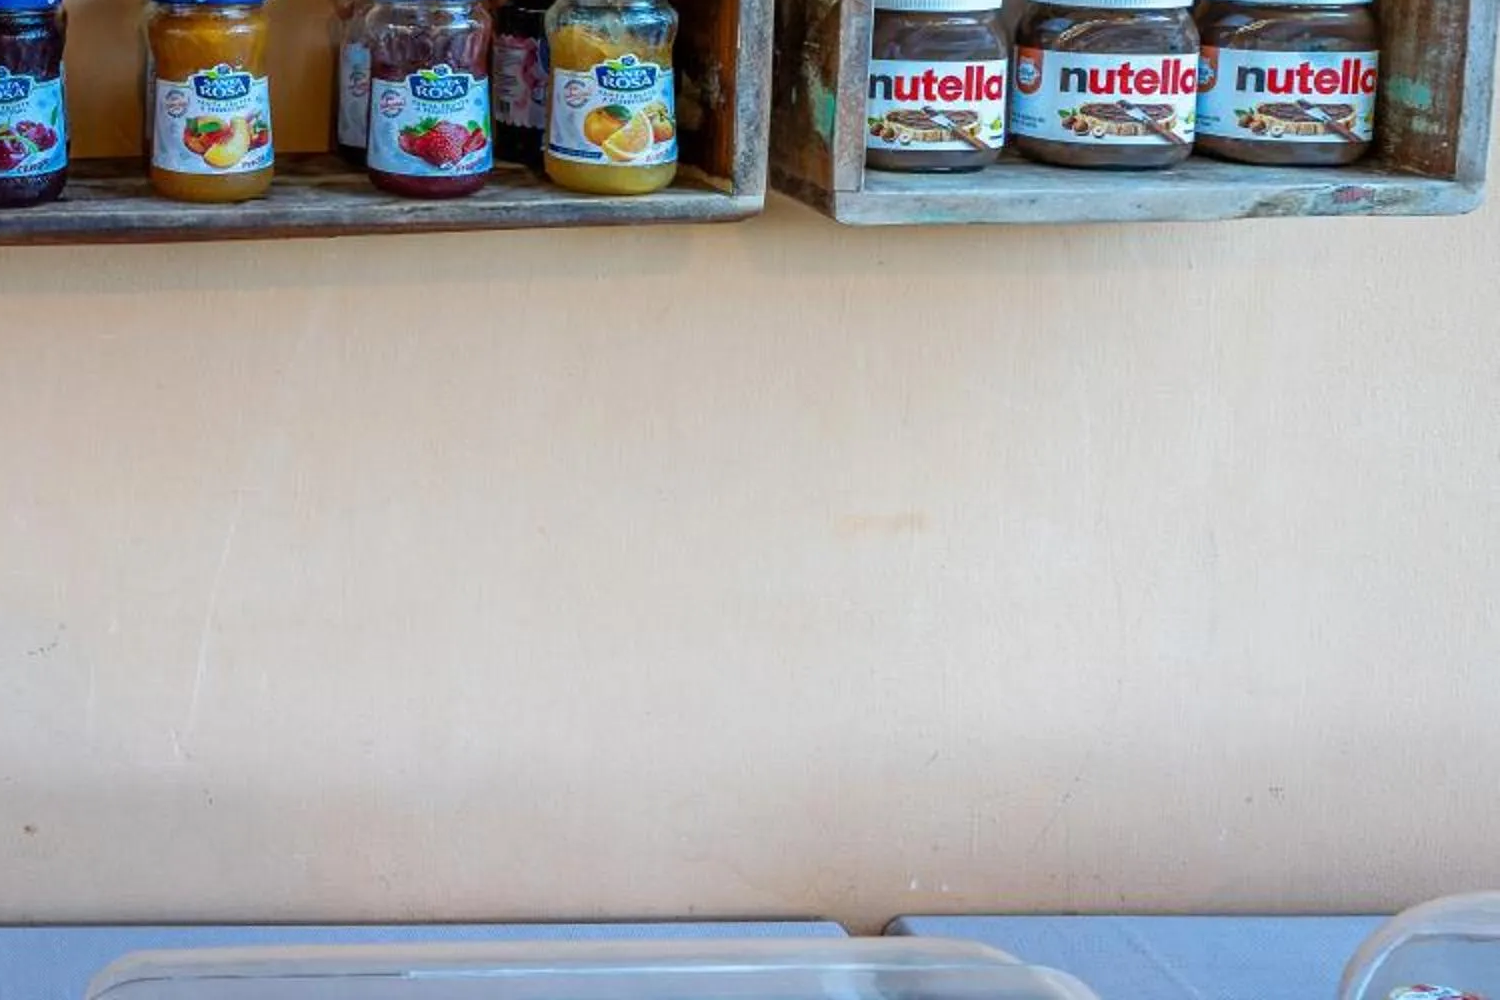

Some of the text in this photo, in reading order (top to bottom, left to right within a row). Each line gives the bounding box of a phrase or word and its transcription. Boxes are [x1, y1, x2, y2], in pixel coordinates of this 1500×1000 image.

[602, 75, 653, 88] ROSA
[869, 66, 1003, 101] nutella
[1060, 59, 1197, 95] nutella
[1236, 59, 1377, 94] nutella
[200, 86, 247, 98] ROSA
[416, 86, 465, 98] ROSA
